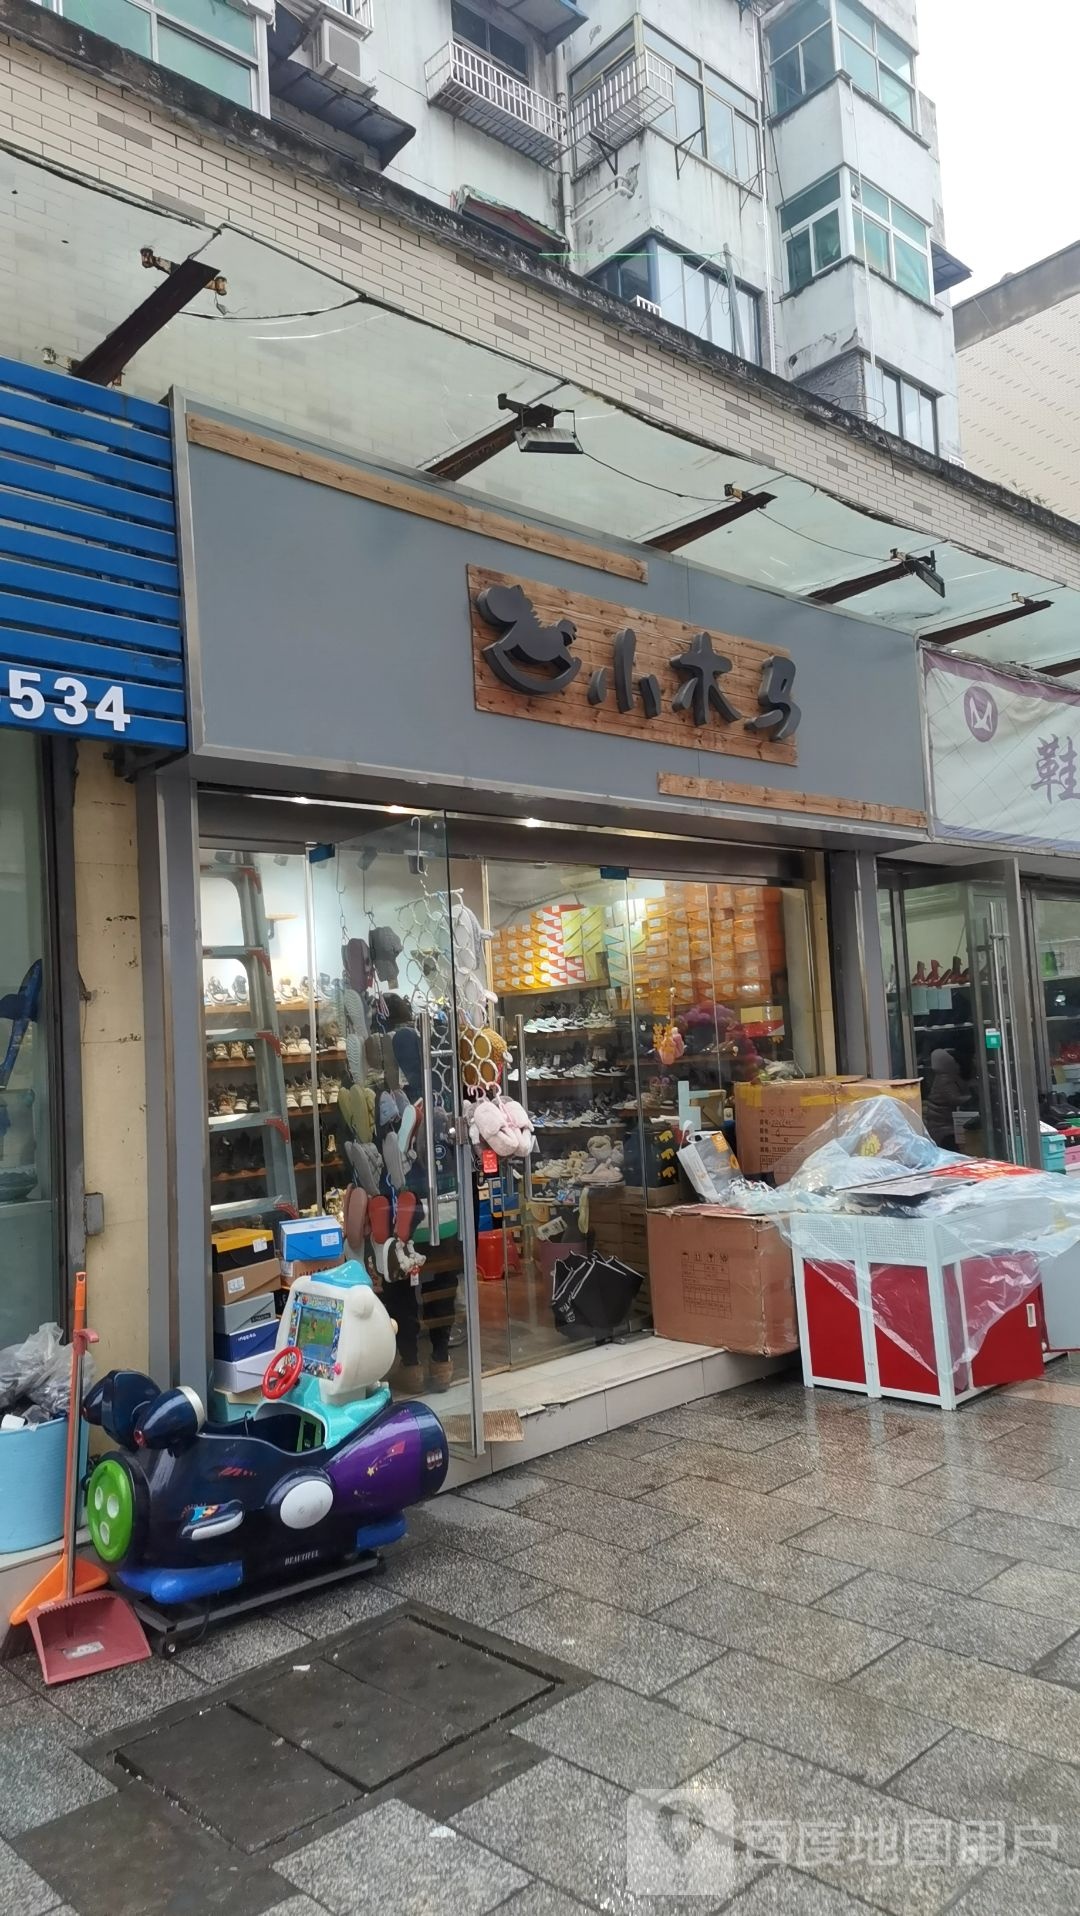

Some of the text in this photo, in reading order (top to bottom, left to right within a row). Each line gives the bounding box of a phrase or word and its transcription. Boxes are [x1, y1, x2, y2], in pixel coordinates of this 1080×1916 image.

[587, 628, 802, 742] 小木马
[1031, 733, 1080, 805] 鞋
